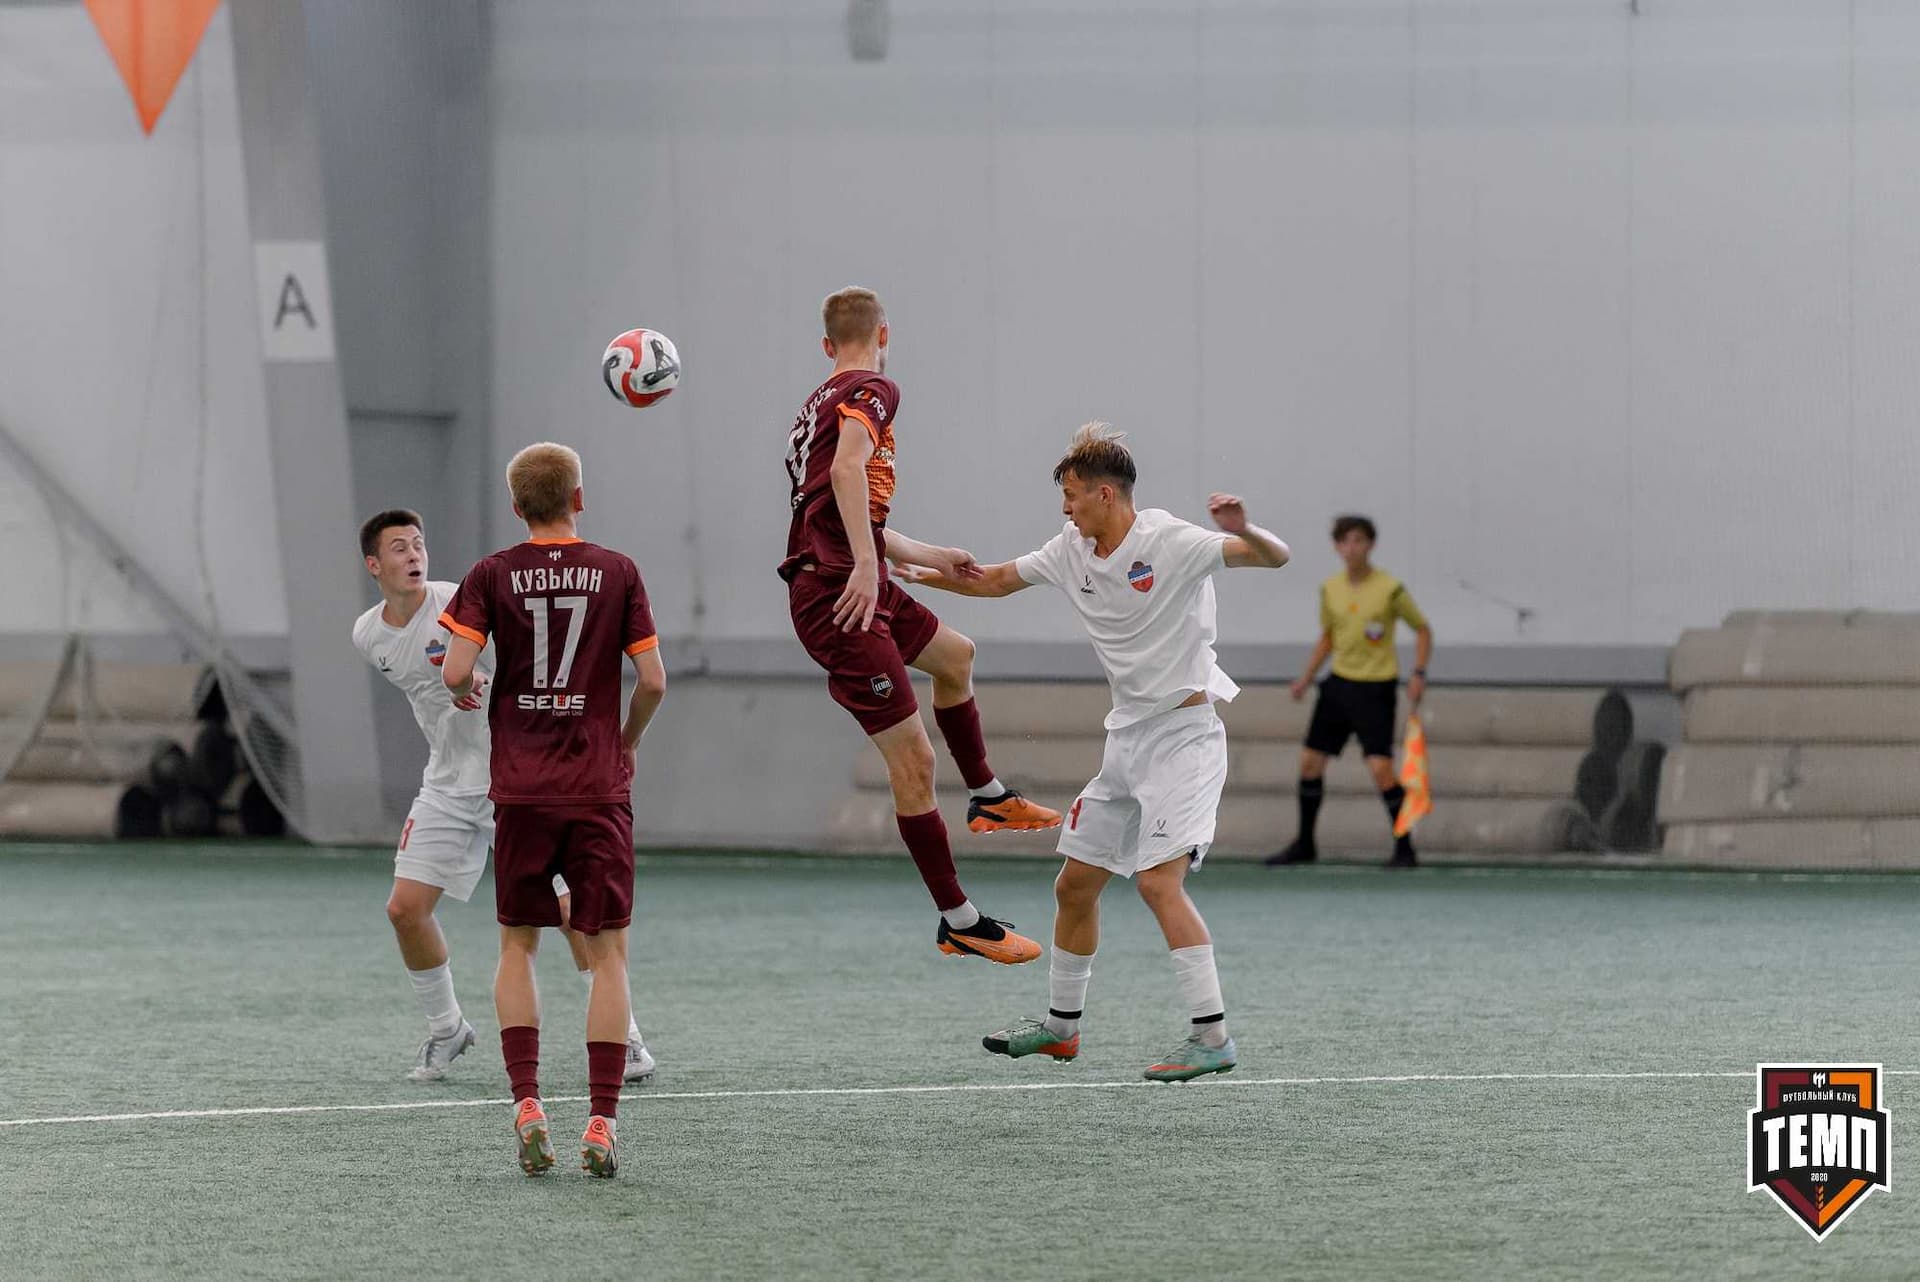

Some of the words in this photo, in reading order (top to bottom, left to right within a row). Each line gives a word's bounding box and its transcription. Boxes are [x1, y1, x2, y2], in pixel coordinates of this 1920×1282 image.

[510, 567, 603, 594] КУЗЬКИН
[524, 596, 588, 689] 17
[517, 694, 586, 710] SEUS
